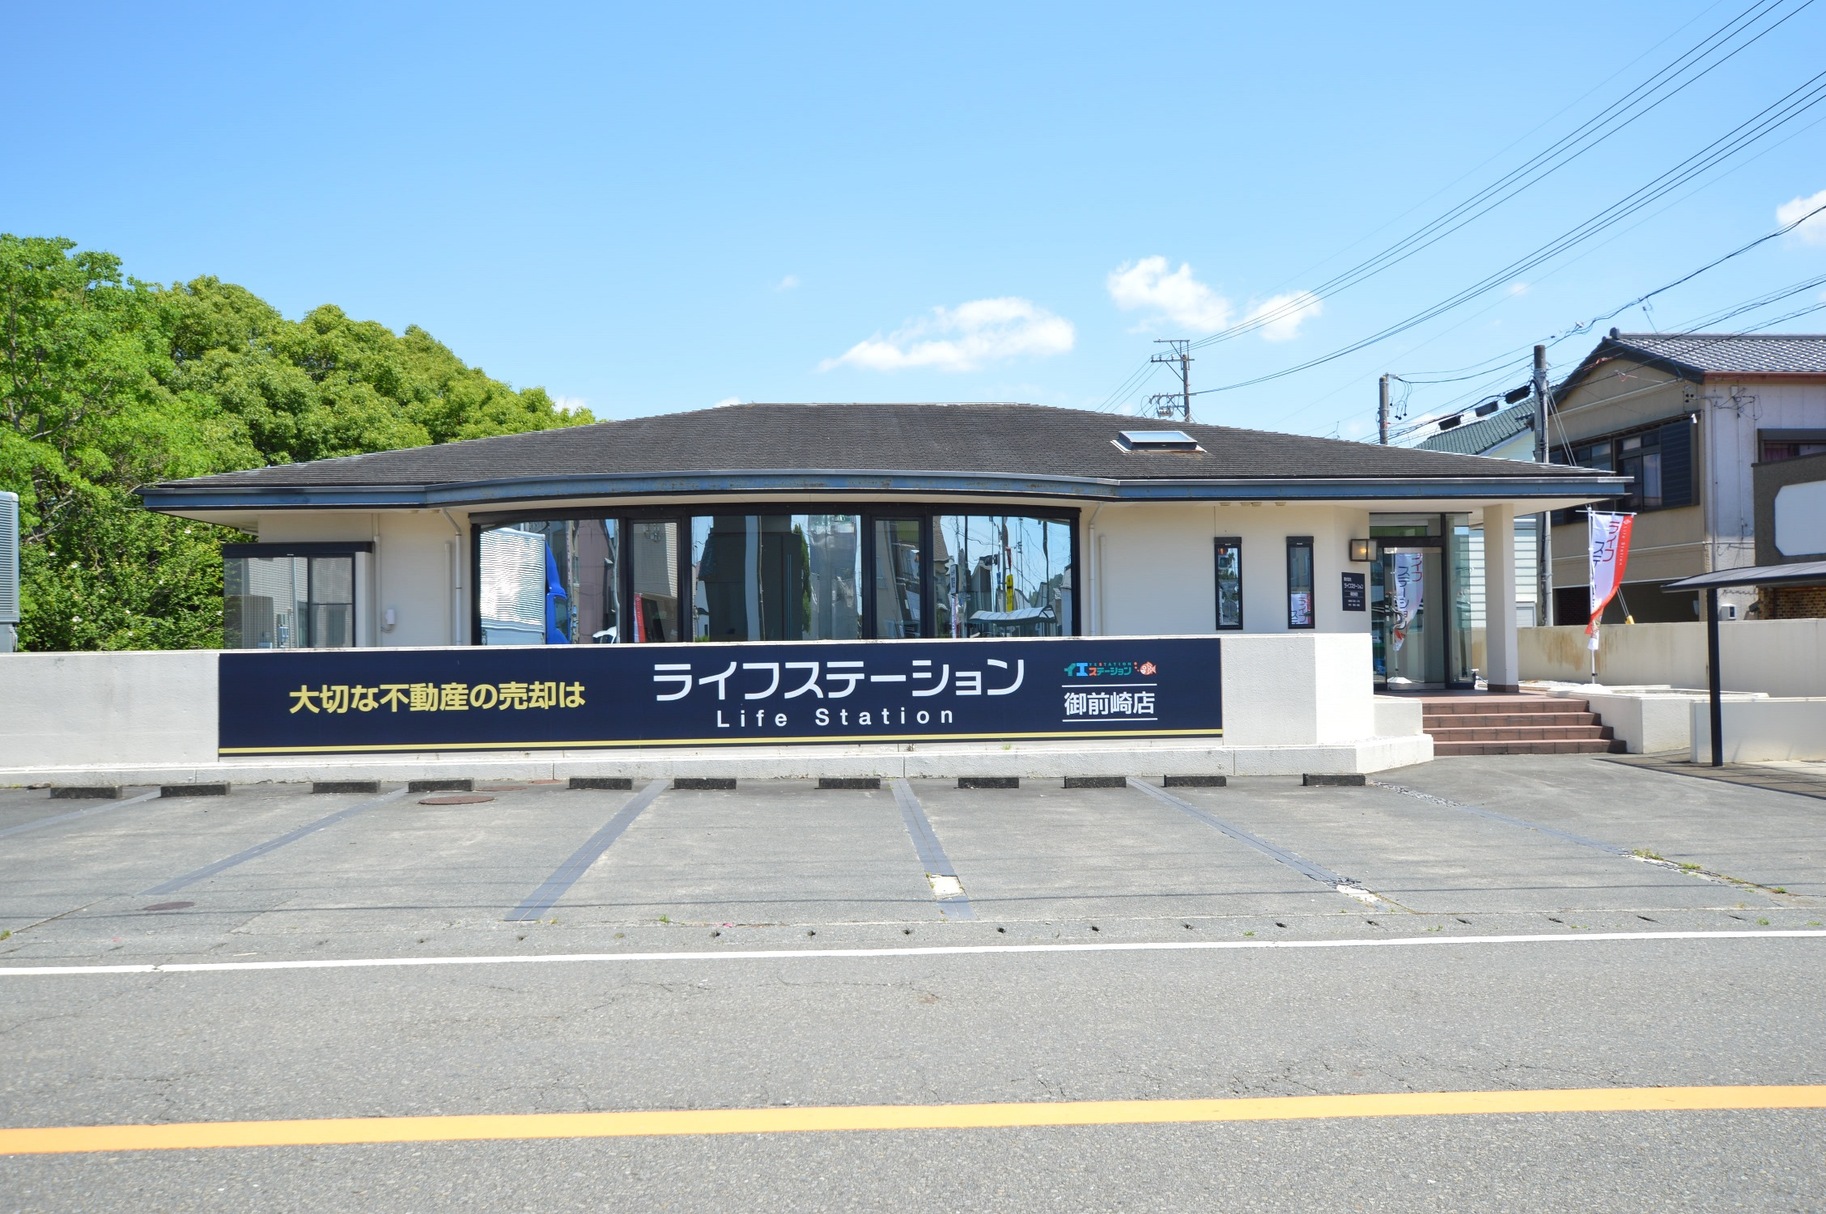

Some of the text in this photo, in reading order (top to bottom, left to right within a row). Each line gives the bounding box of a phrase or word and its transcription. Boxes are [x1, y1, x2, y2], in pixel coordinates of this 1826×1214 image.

[1602, 521, 1620, 562] ライフ
[289, 680, 586, 714] 大切な不動産の売却は
[653, 658, 1025, 702] ライフステーション
[717, 706, 953, 728] Life Station
[1063, 690, 1156, 716] 御前崎店
